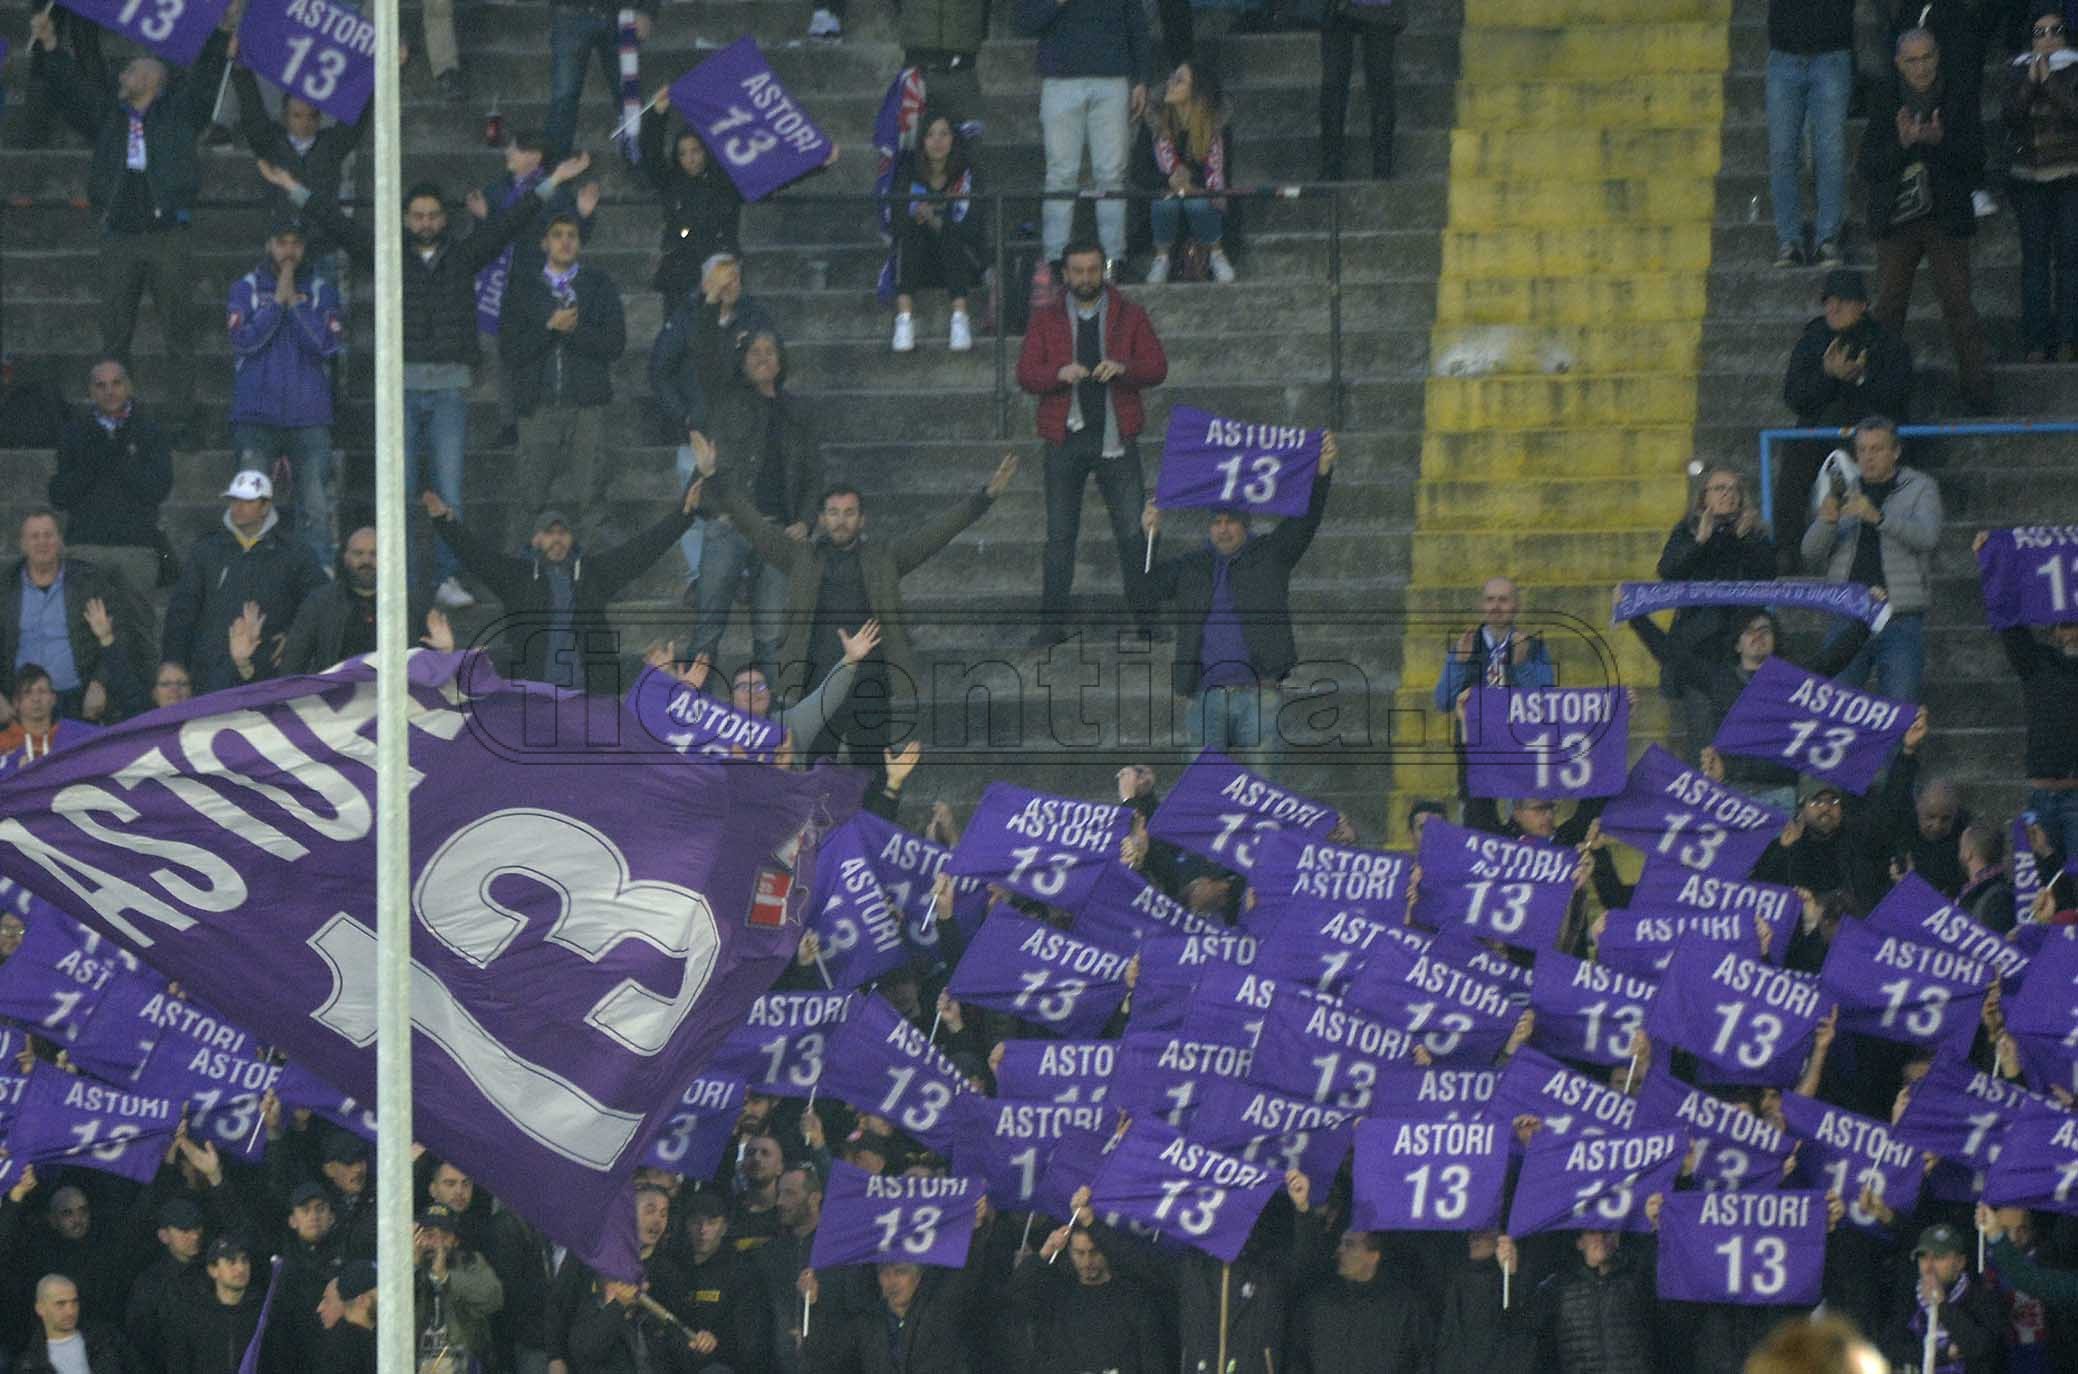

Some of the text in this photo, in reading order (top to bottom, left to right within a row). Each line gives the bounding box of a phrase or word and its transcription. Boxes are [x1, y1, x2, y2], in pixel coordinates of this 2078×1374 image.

[286, 0, 375, 56] ASTOR
[281, 36, 347, 101] 13
[709, 106, 778, 167] 13
[741, 71, 820, 152] ASTORI
[1205, 418, 1306, 450] ASTORI
[1216, 455, 1281, 504] 13
[666, 690, 771, 751] ASTORI
[1510, 691, 1612, 724] ASTORI
[1787, 677, 1901, 731] ASTORI
[1524, 732, 1593, 788] 13
[1781, 719, 1856, 769] 13
[1221, 773, 1329, 828] ASTORI
[1664, 770, 1772, 829] ASTORI
[1657, 812, 1728, 870] 13
[1007, 846, 1079, 896] 13
[840, 856, 903, 953] ASTORI
[1463, 880, 1533, 933] 13
[1019, 927, 1130, 982] ASTORI
[1873, 937, 1985, 986] ASTORI
[1921, 905, 2031, 978] ASTORI
[305, 806, 721, 1173] 13
[747, 995, 850, 1027] ASTORI
[1013, 969, 1088, 1021] 13
[1405, 956, 1509, 1018] ASTORI
[1711, 951, 1821, 1018] ASTORI
[1879, 978, 1950, 1036] 13
[1304, 1005, 1412, 1060] ASTORI
[1407, 1001, 1474, 1055] 13
[1576, 1000, 1644, 1059] 13
[1710, 1001, 1783, 1069] 13
[760, 1033, 825, 1087] 13
[1038, 1044, 1115, 1078] ASTO
[1157, 1038, 1255, 1078] ASTOR
[1312, 1052, 1377, 1110] 13
[65, 1081, 170, 1121] ASTORI
[191, 1089, 258, 1141] 13
[879, 1066, 952, 1132] 13
[995, 1104, 1104, 1139] ASTORI
[1541, 1069, 1638, 1131] ASTOR
[1674, 1090, 1782, 1153] ASTORI
[66, 1119, 141, 1162] 13
[1158, 1136, 1269, 1190] ASTORI
[1392, 1123, 1496, 1156] ASTORI
[1565, 1134, 1676, 1172] ASTORI
[1815, 1111, 1915, 1169] ASTORI
[866, 1175, 969, 1199] ASTORI
[1154, 1179, 1227, 1236] 13
[1405, 1163, 1472, 1220] 13
[1699, 1192, 1813, 1228] ASTORI
[873, 1205, 944, 1255] 13
[1715, 1235, 1788, 1296] 13
